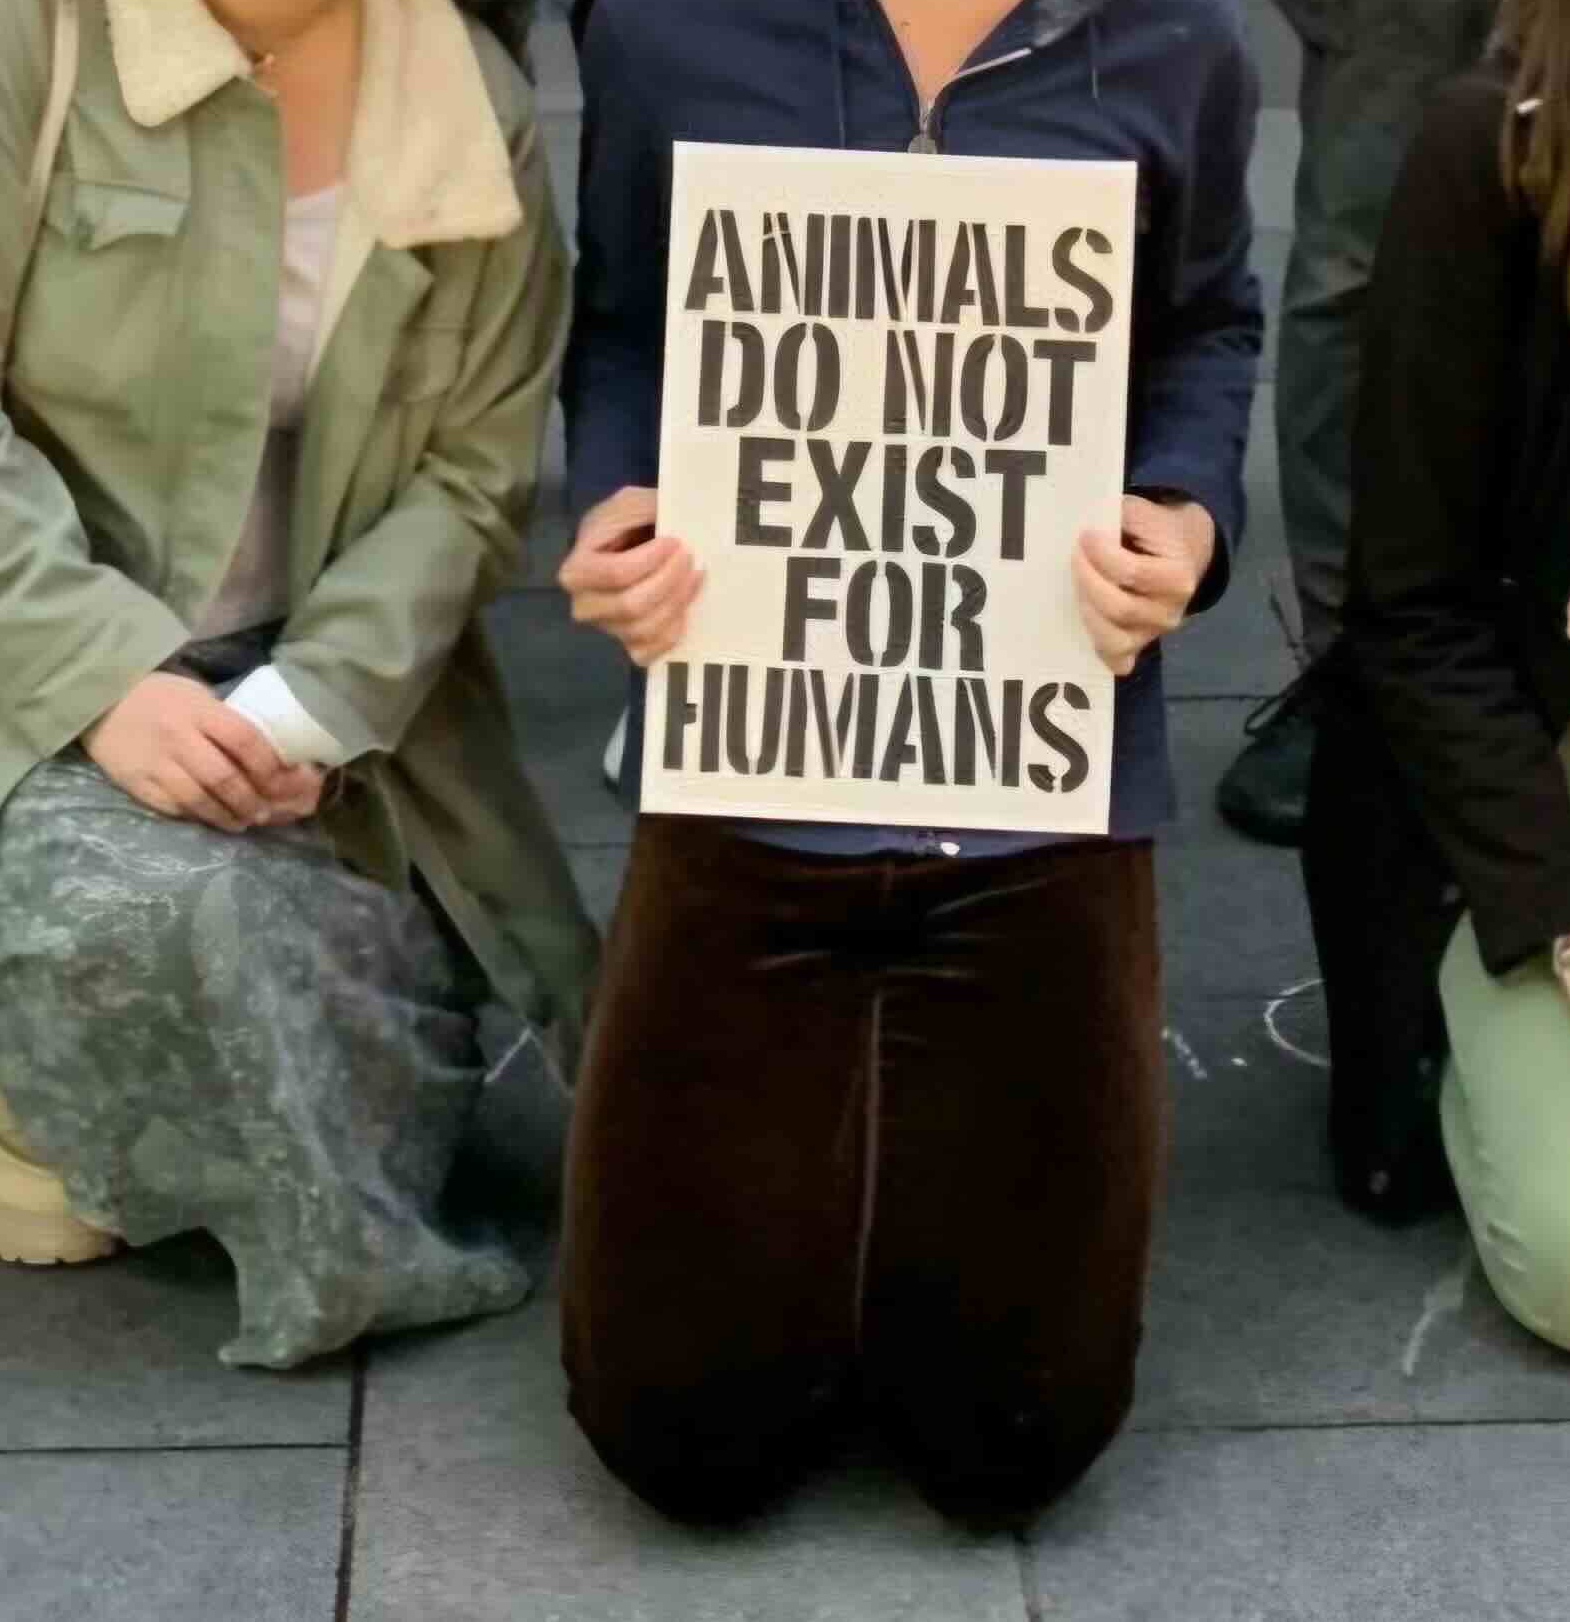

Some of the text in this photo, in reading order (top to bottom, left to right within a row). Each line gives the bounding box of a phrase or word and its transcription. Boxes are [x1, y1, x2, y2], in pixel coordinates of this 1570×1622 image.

[684, 208, 1114, 333] ANIMALS
[697, 319, 1095, 446] DO NOT
[735, 437, 1047, 561] EXIST
[782, 557, 989, 672] FOR
[663, 663, 1090, 794] HUMANS
